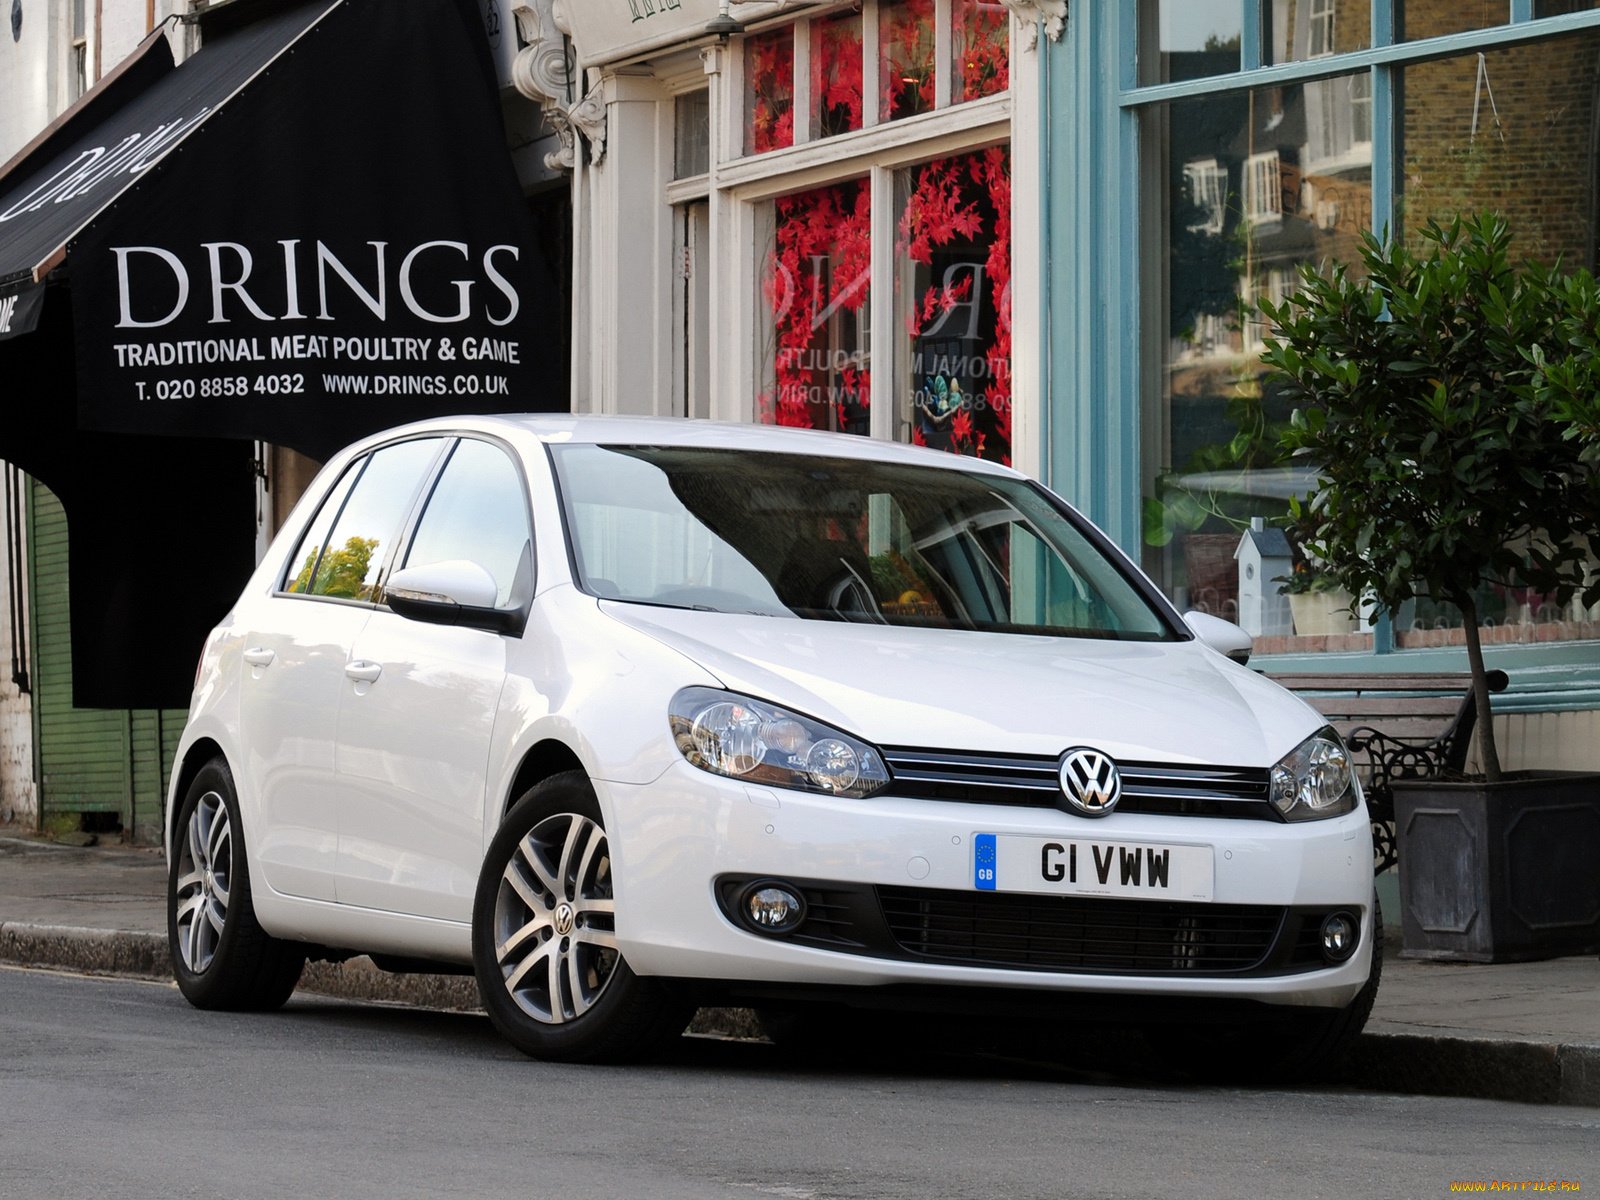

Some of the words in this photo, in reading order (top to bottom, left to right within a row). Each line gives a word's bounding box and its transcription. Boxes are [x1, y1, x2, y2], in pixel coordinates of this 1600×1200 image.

[109, 239, 520, 328] DRINGS
[113, 337, 266, 368] TRADITIONAL
[270, 335, 329, 361] MEAT
[333, 336, 432, 362] POULTRY
[437, 338, 456, 361] &
[462, 337, 521, 365] GAME
[135, 381, 151, 401] T.
[156, 379, 196, 400] 020
[200, 376, 249, 397] 8858
[253, 374, 305, 395] 4032
[322, 373, 510, 396] WWW.DRINGS.CO.UK
[1060, 750, 1121, 810] VW
[978, 868, 993, 880] GB
[1091, 844, 1170, 888] VWW
